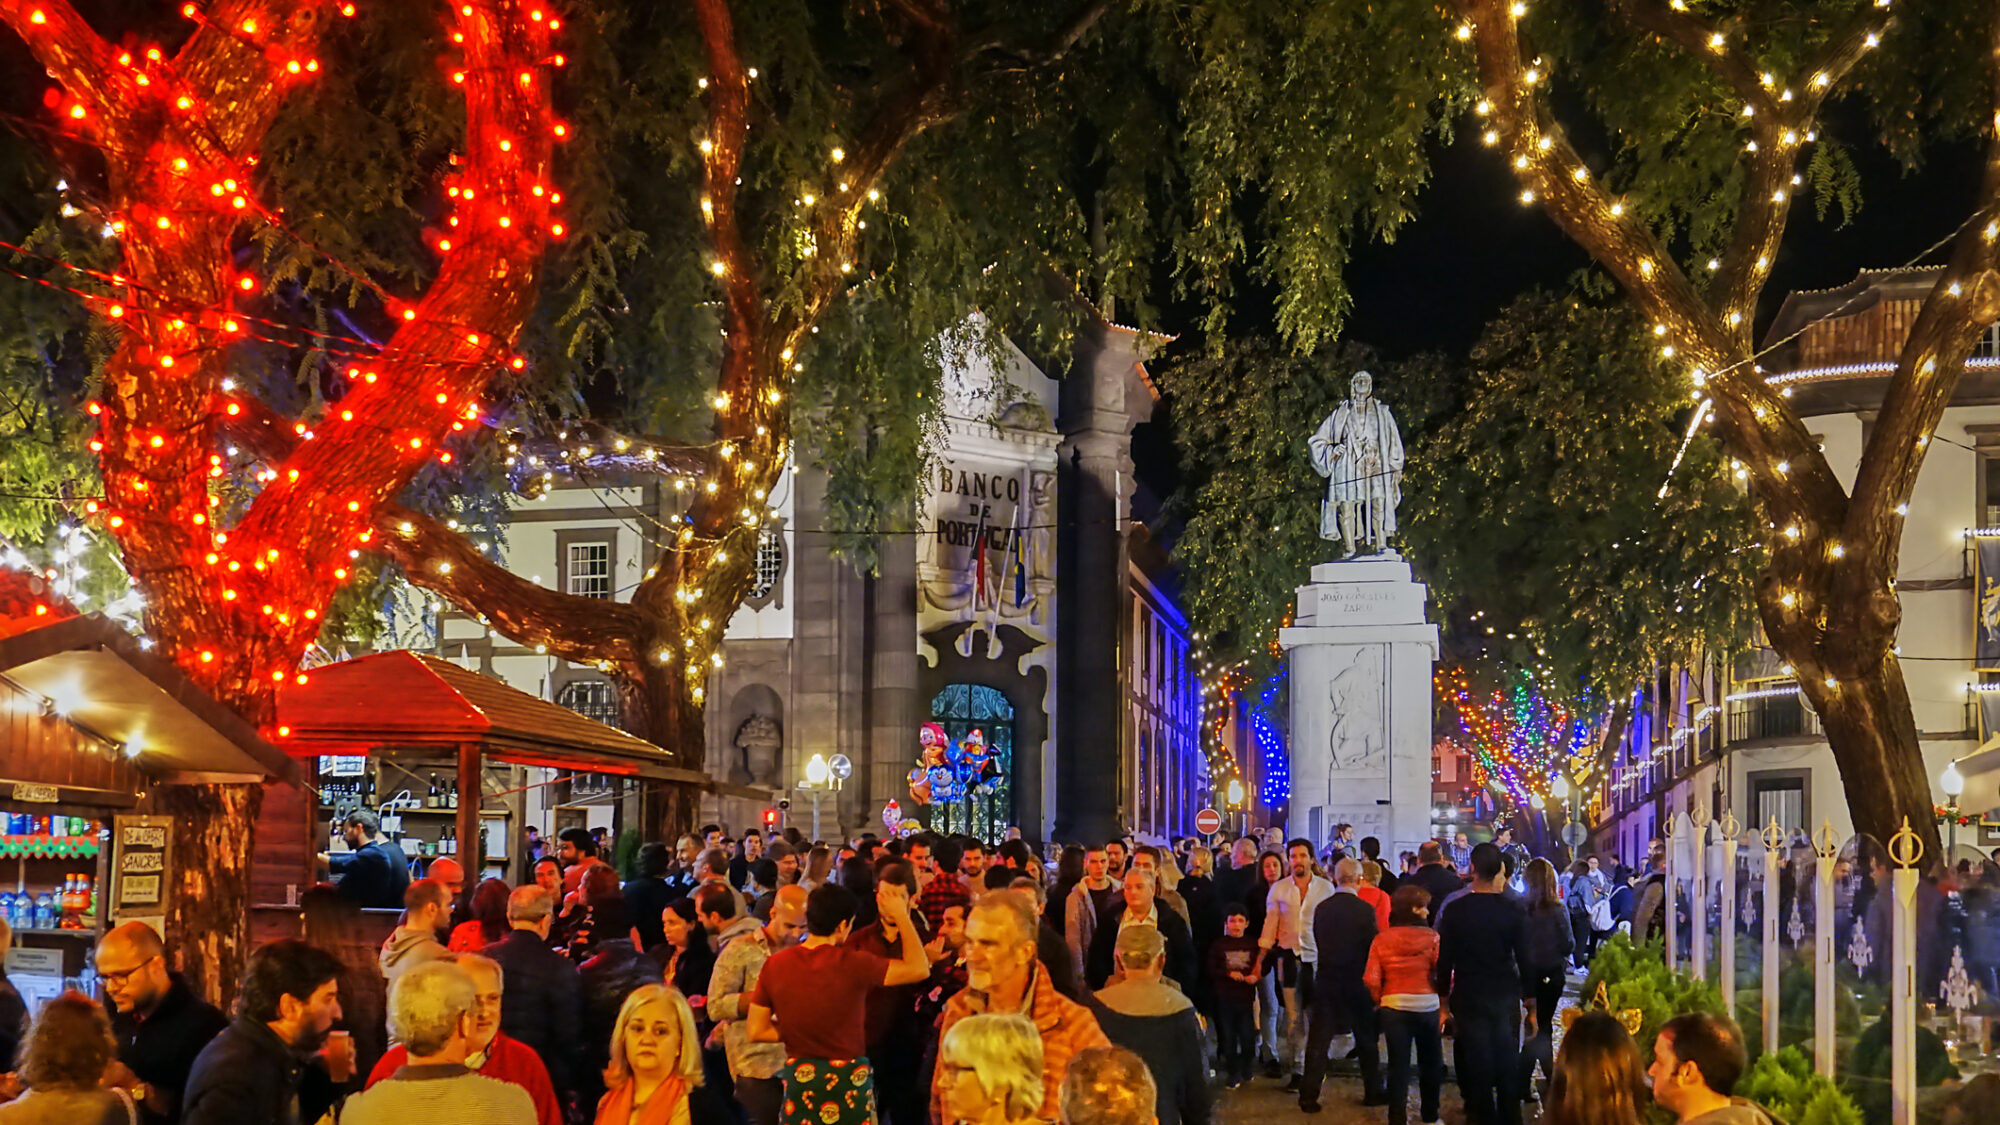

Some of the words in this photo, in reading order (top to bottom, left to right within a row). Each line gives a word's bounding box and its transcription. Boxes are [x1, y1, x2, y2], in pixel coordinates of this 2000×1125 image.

[940, 465, 1019, 502] BANCO
[969, 503, 991, 518] DE
[937, 518, 1017, 552] PORTUGA
